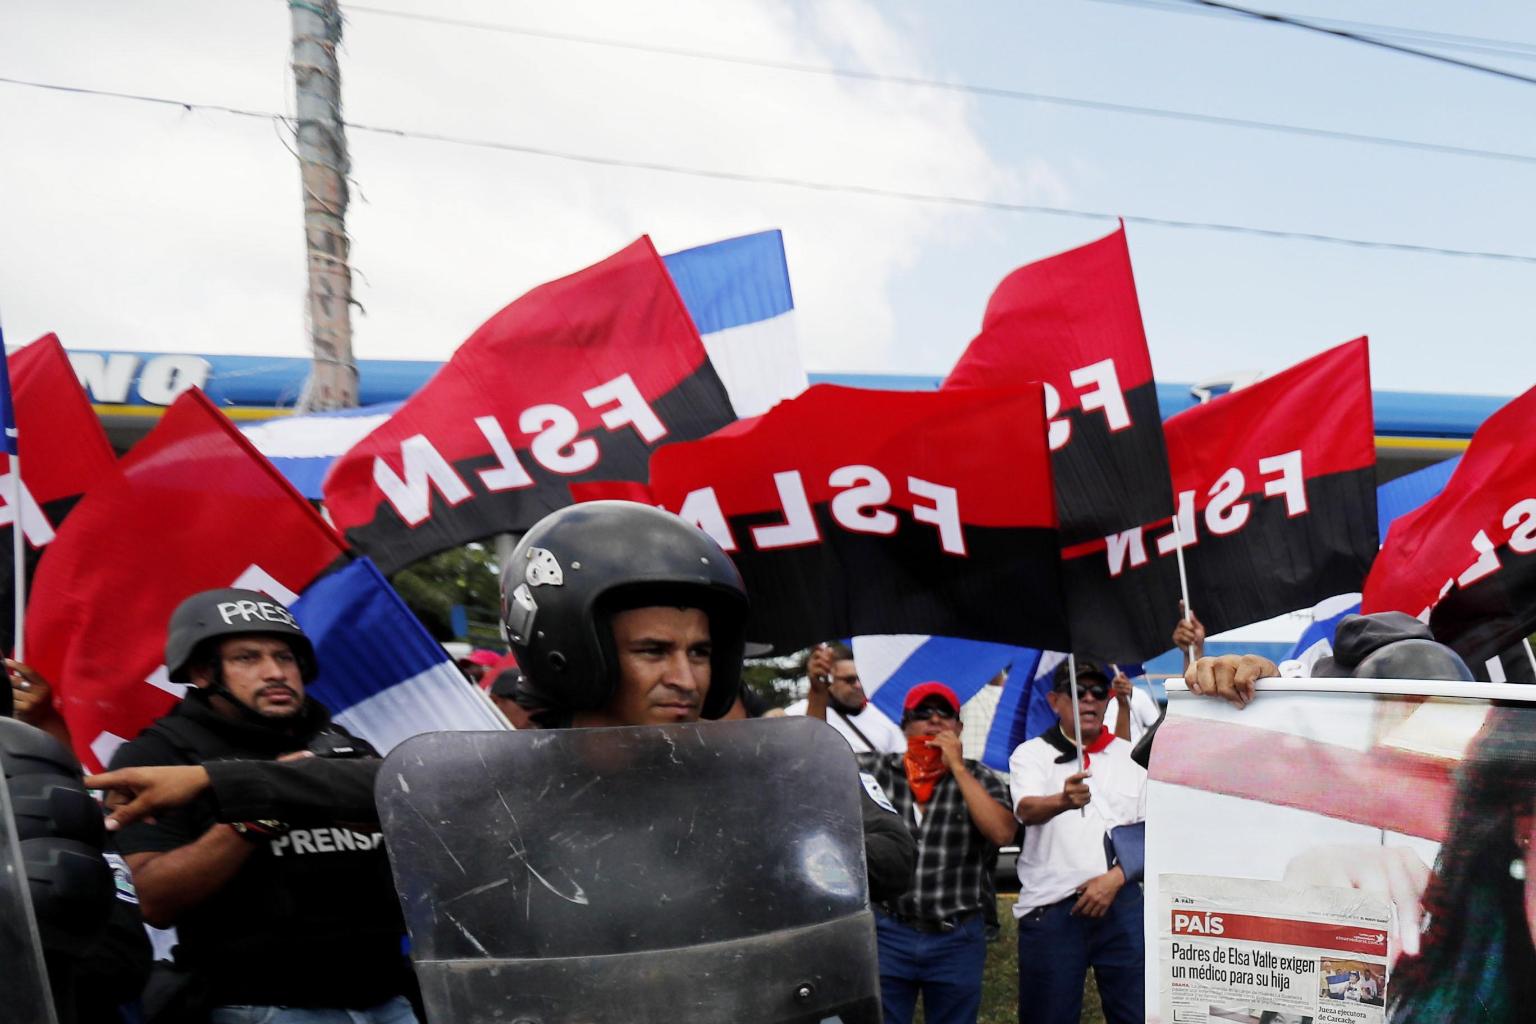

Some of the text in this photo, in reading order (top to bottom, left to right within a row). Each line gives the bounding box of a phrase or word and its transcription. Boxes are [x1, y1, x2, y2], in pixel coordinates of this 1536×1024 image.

[1174, 911, 1225, 936] PAÍS
[1172, 942, 1316, 975] Padres de Elsa Valle exigen
[1172, 964, 1290, 992] un médico para su hija
[1318, 1006, 1367, 1019] Jueza ejecutora
[1326, 1015, 1356, 1024] Carcache
